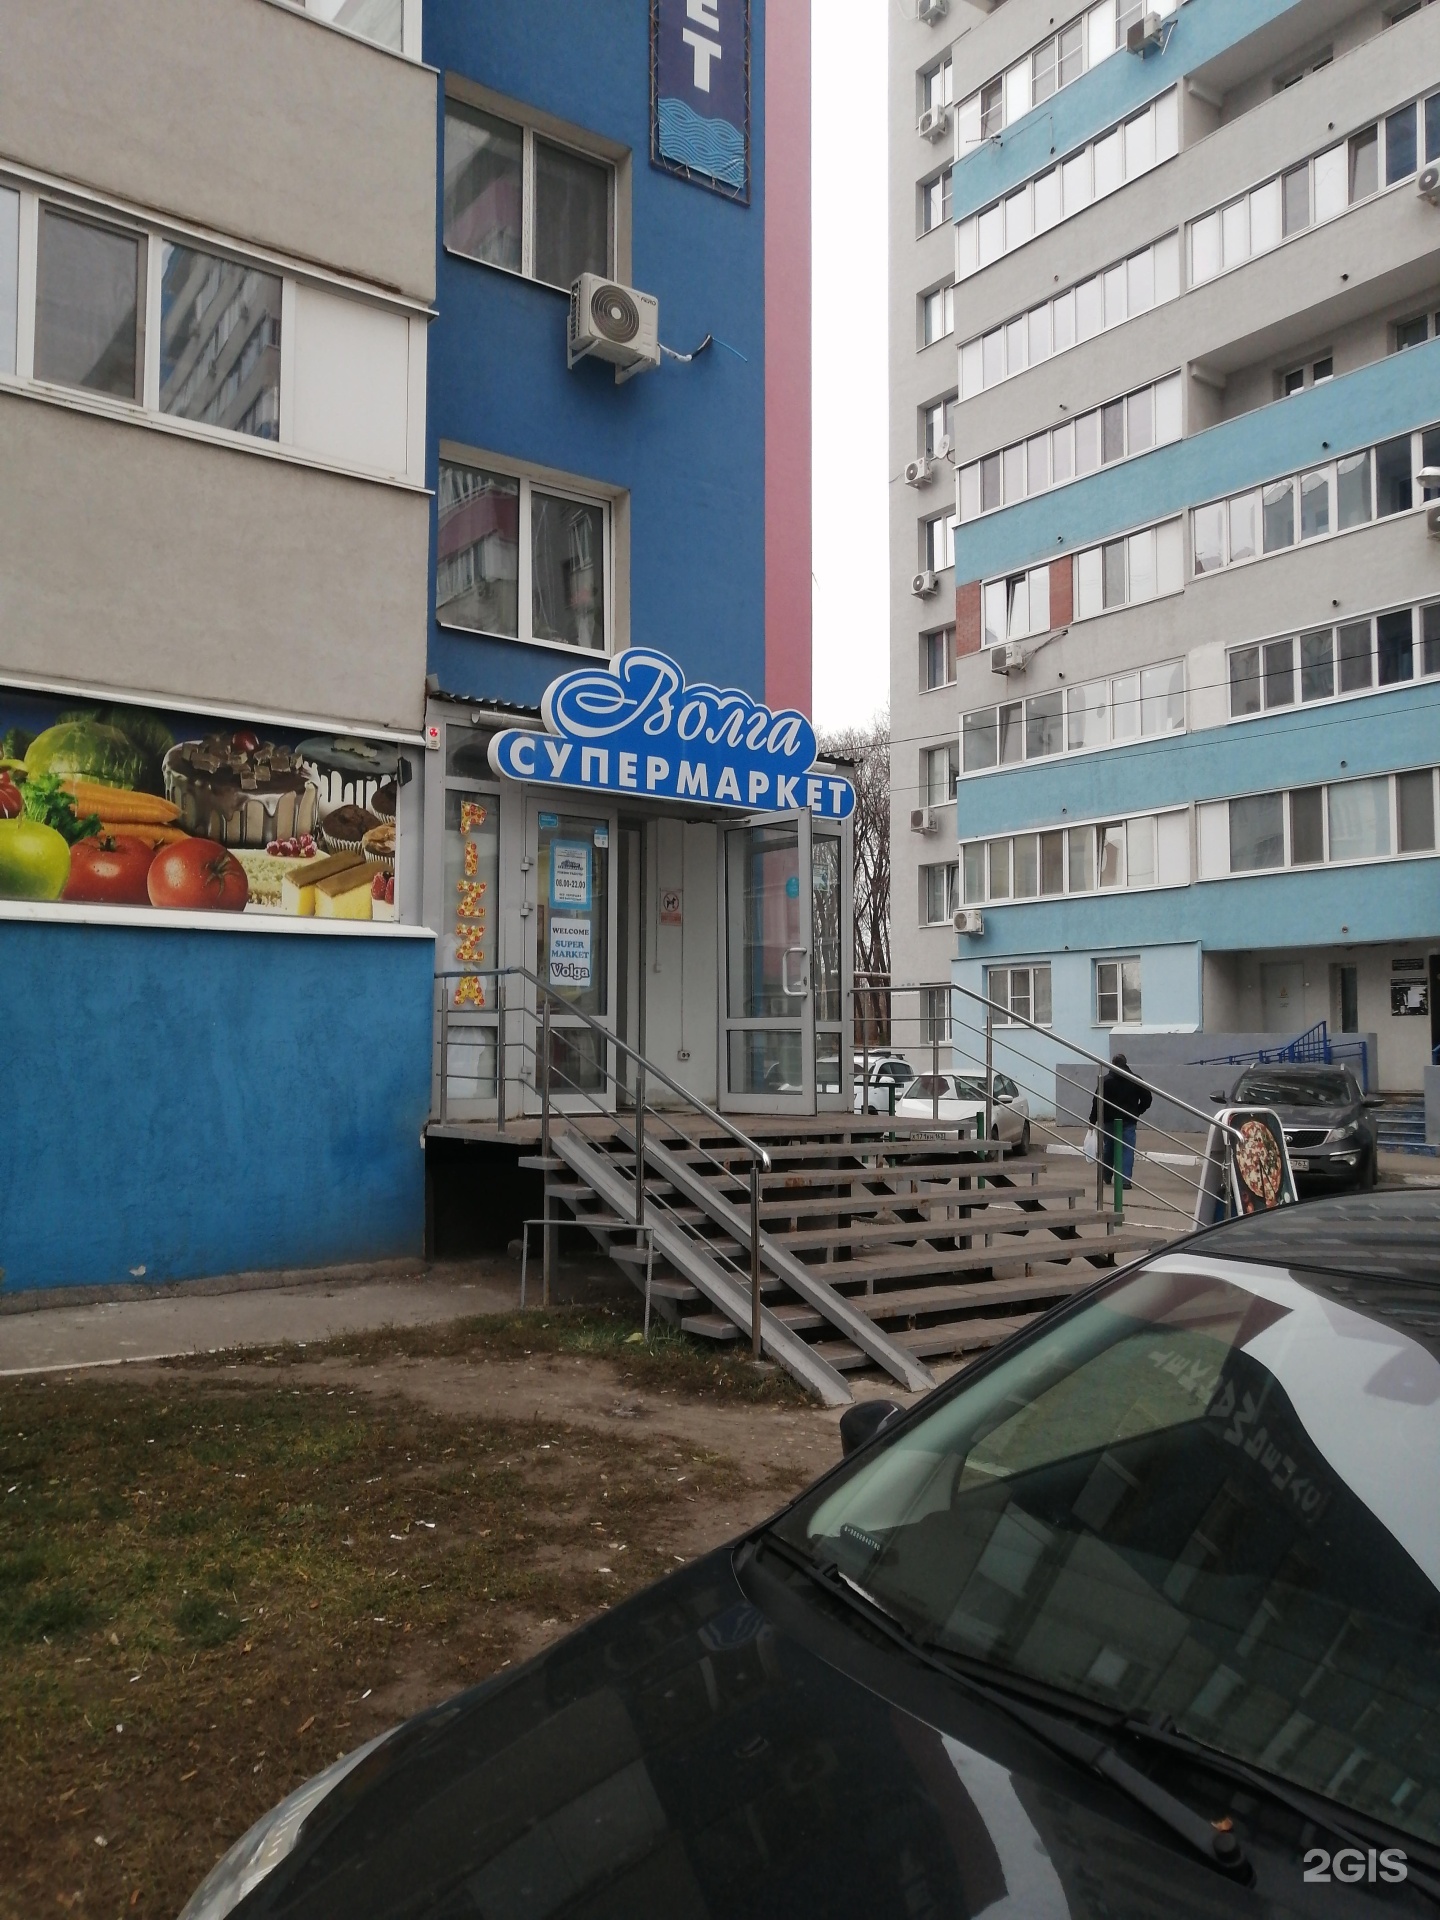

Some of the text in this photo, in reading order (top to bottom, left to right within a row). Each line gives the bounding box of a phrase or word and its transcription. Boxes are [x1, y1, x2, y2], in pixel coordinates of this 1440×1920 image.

[557, 655, 803, 757] Волга
[509, 736, 847, 814] СУПЕРМАРКЕТ
[454, 800, 488, 1008] PIZZA
[552, 927, 589, 936] WELCOME
[555, 940, 584, 948] SUPER
[551, 950, 589, 959] MARKET
[550, 962, 590, 981] Volga
